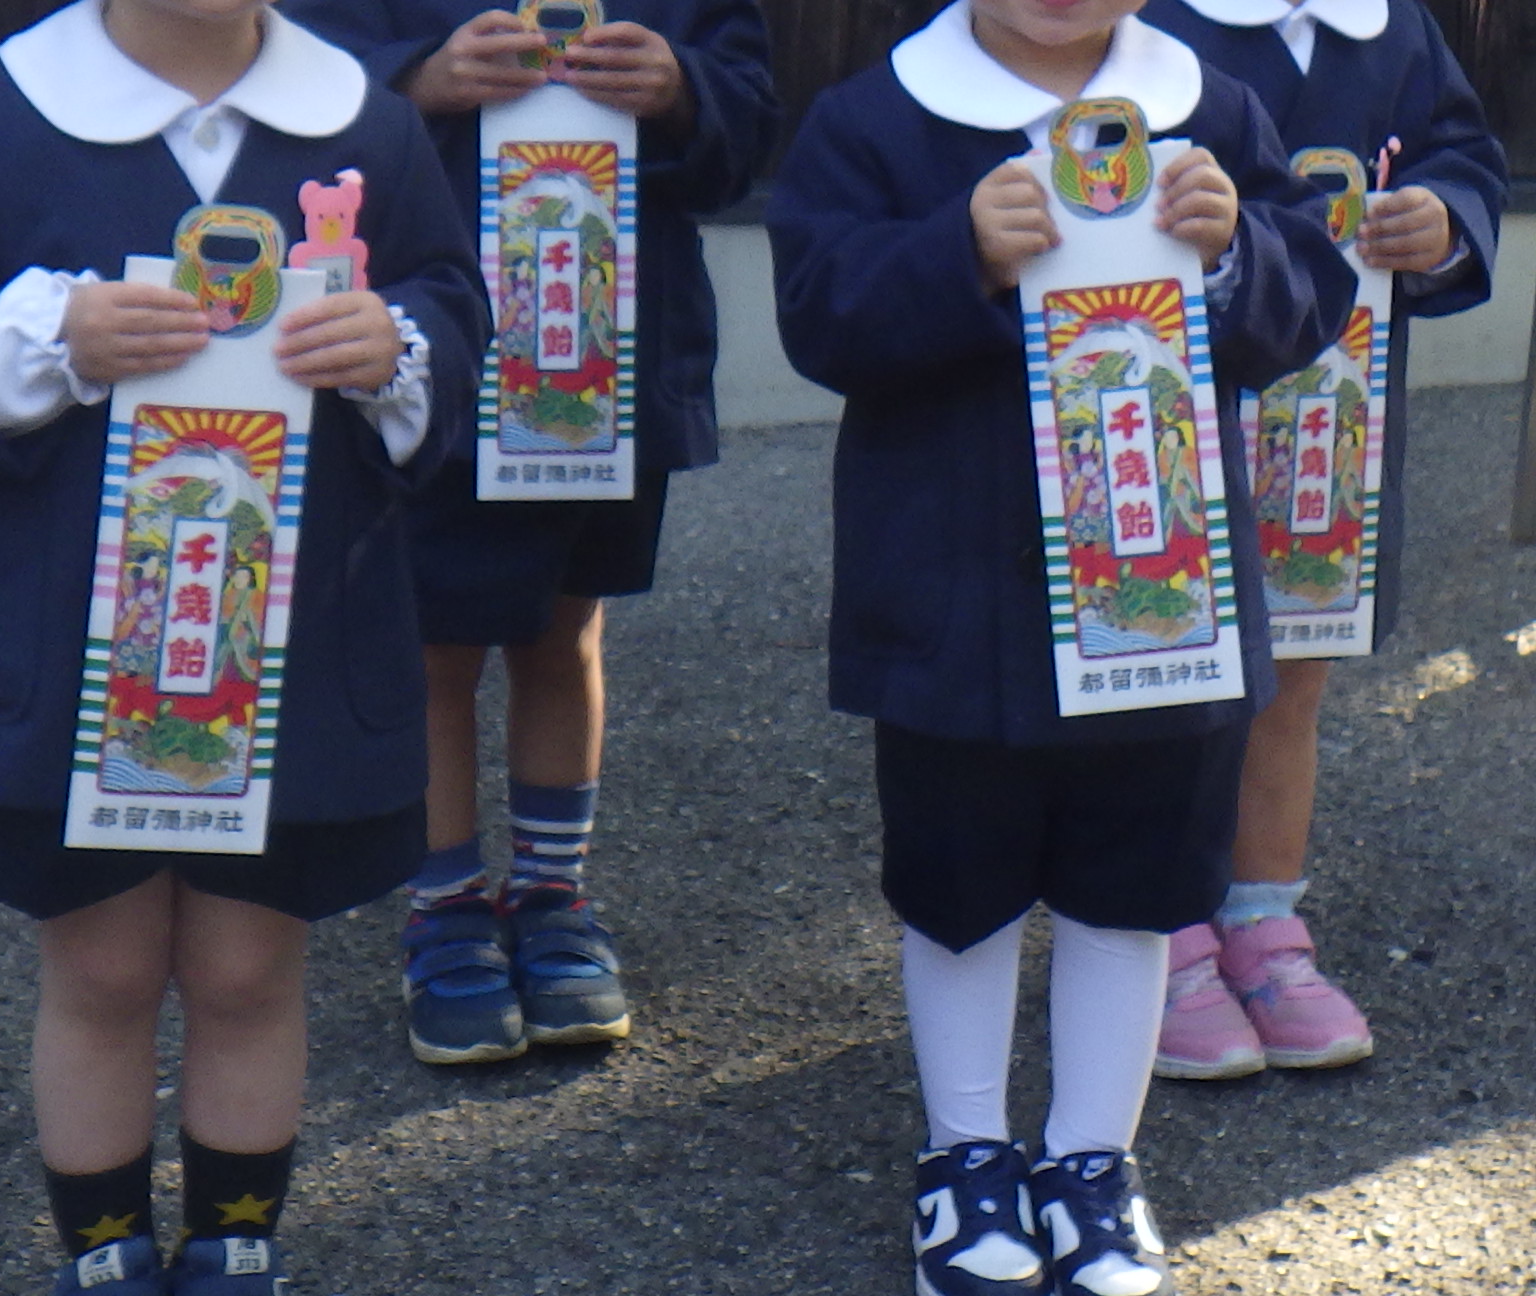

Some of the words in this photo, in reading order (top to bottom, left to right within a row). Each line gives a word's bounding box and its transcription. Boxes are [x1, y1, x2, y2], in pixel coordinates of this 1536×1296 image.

[1108, 401, 1155, 542] 千歳飴
[165, 533, 218, 679] 千歳飴
